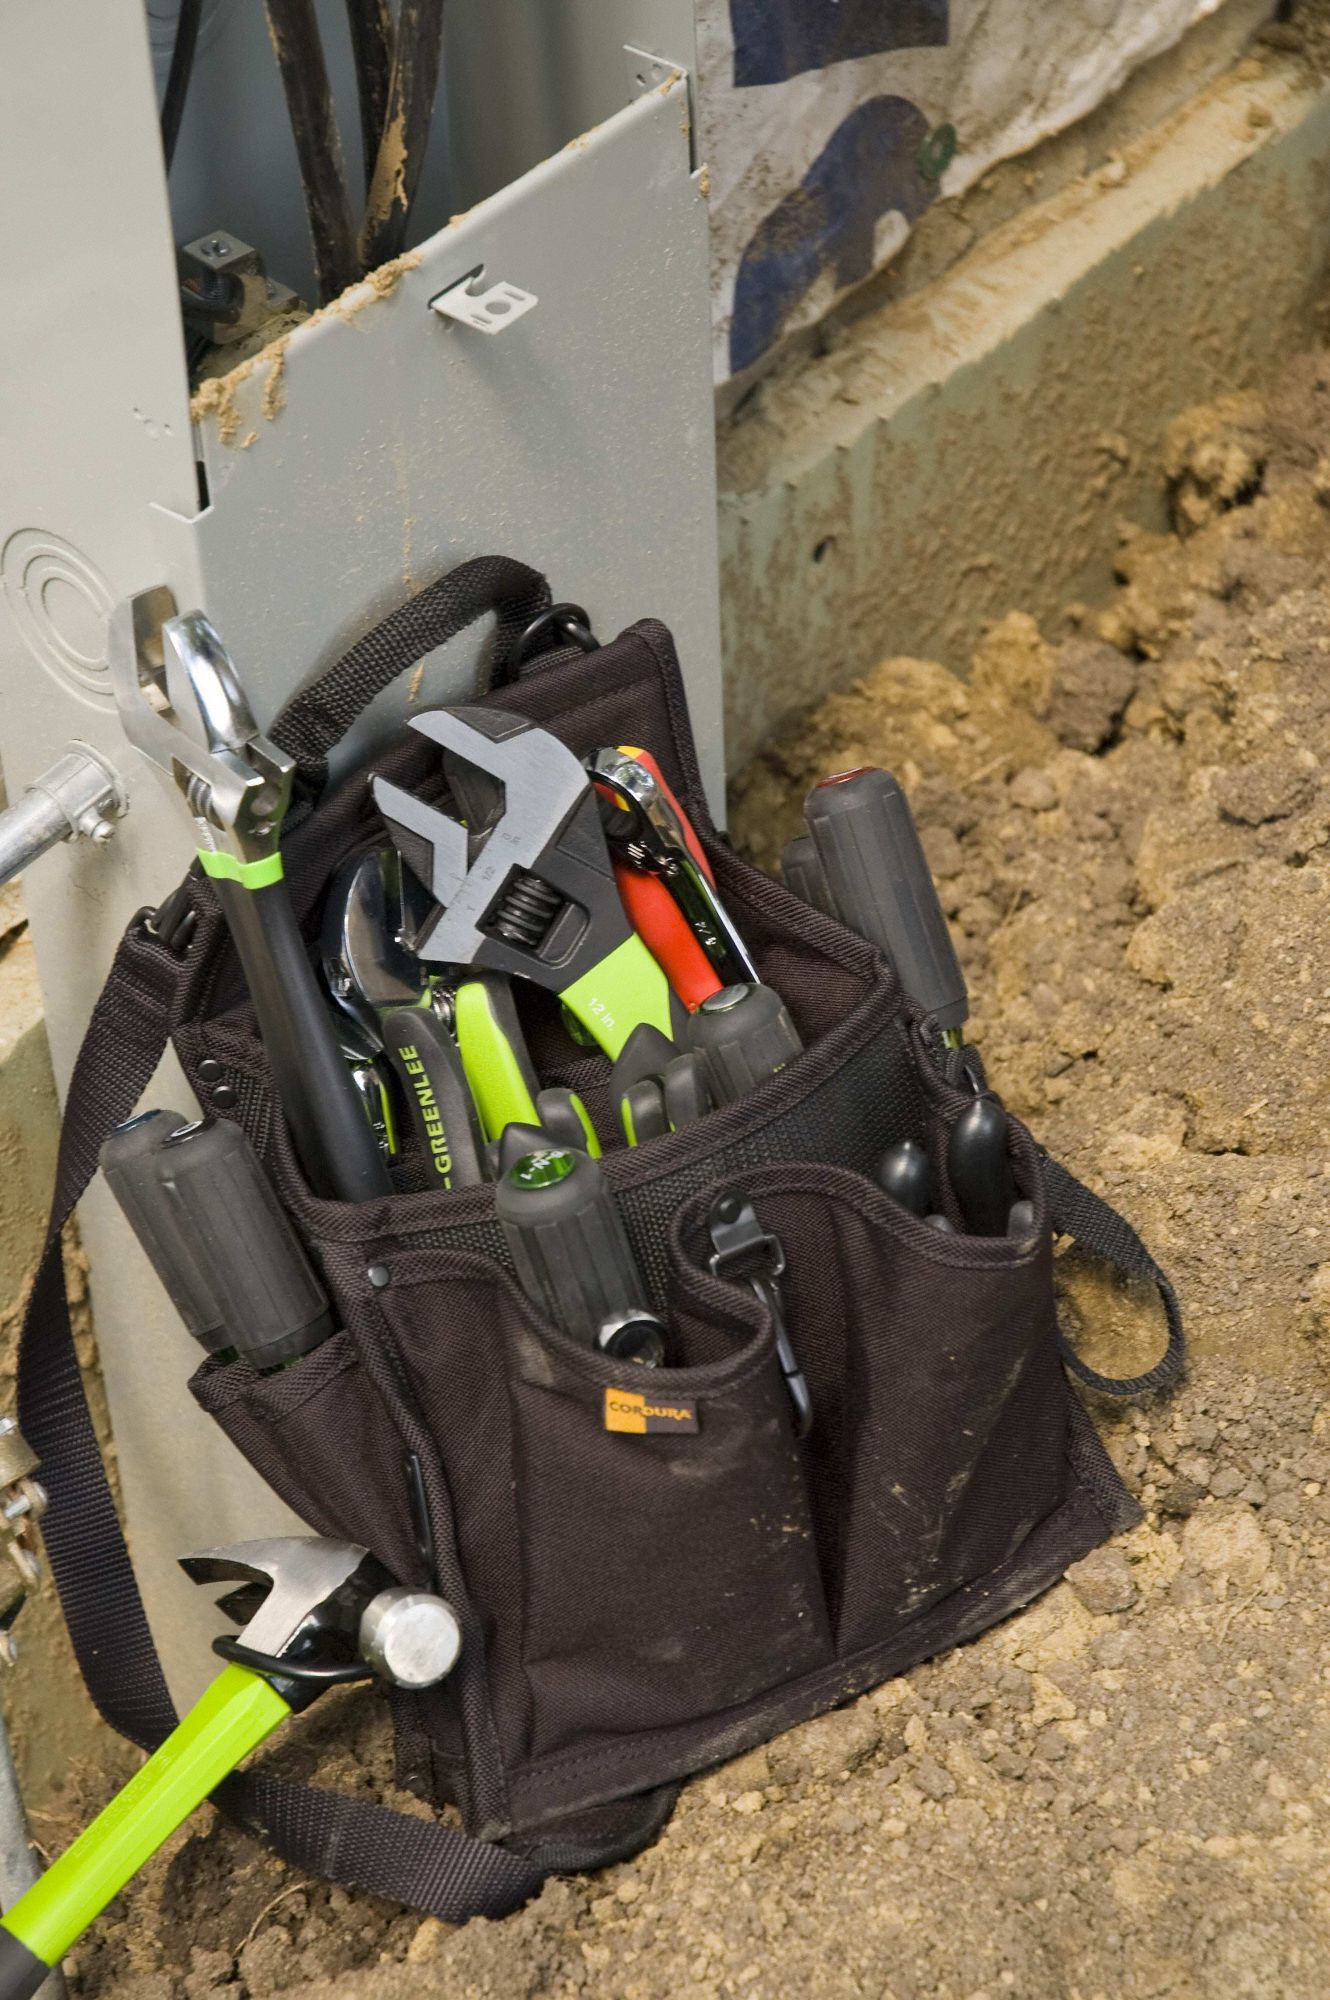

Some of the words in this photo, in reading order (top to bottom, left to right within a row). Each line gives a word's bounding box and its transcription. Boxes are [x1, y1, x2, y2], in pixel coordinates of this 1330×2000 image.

[589, 998, 605, 1015] 12
[400, 1044, 453, 1175] GREENLEE
[609, 1401, 692, 1421] CORDURA
